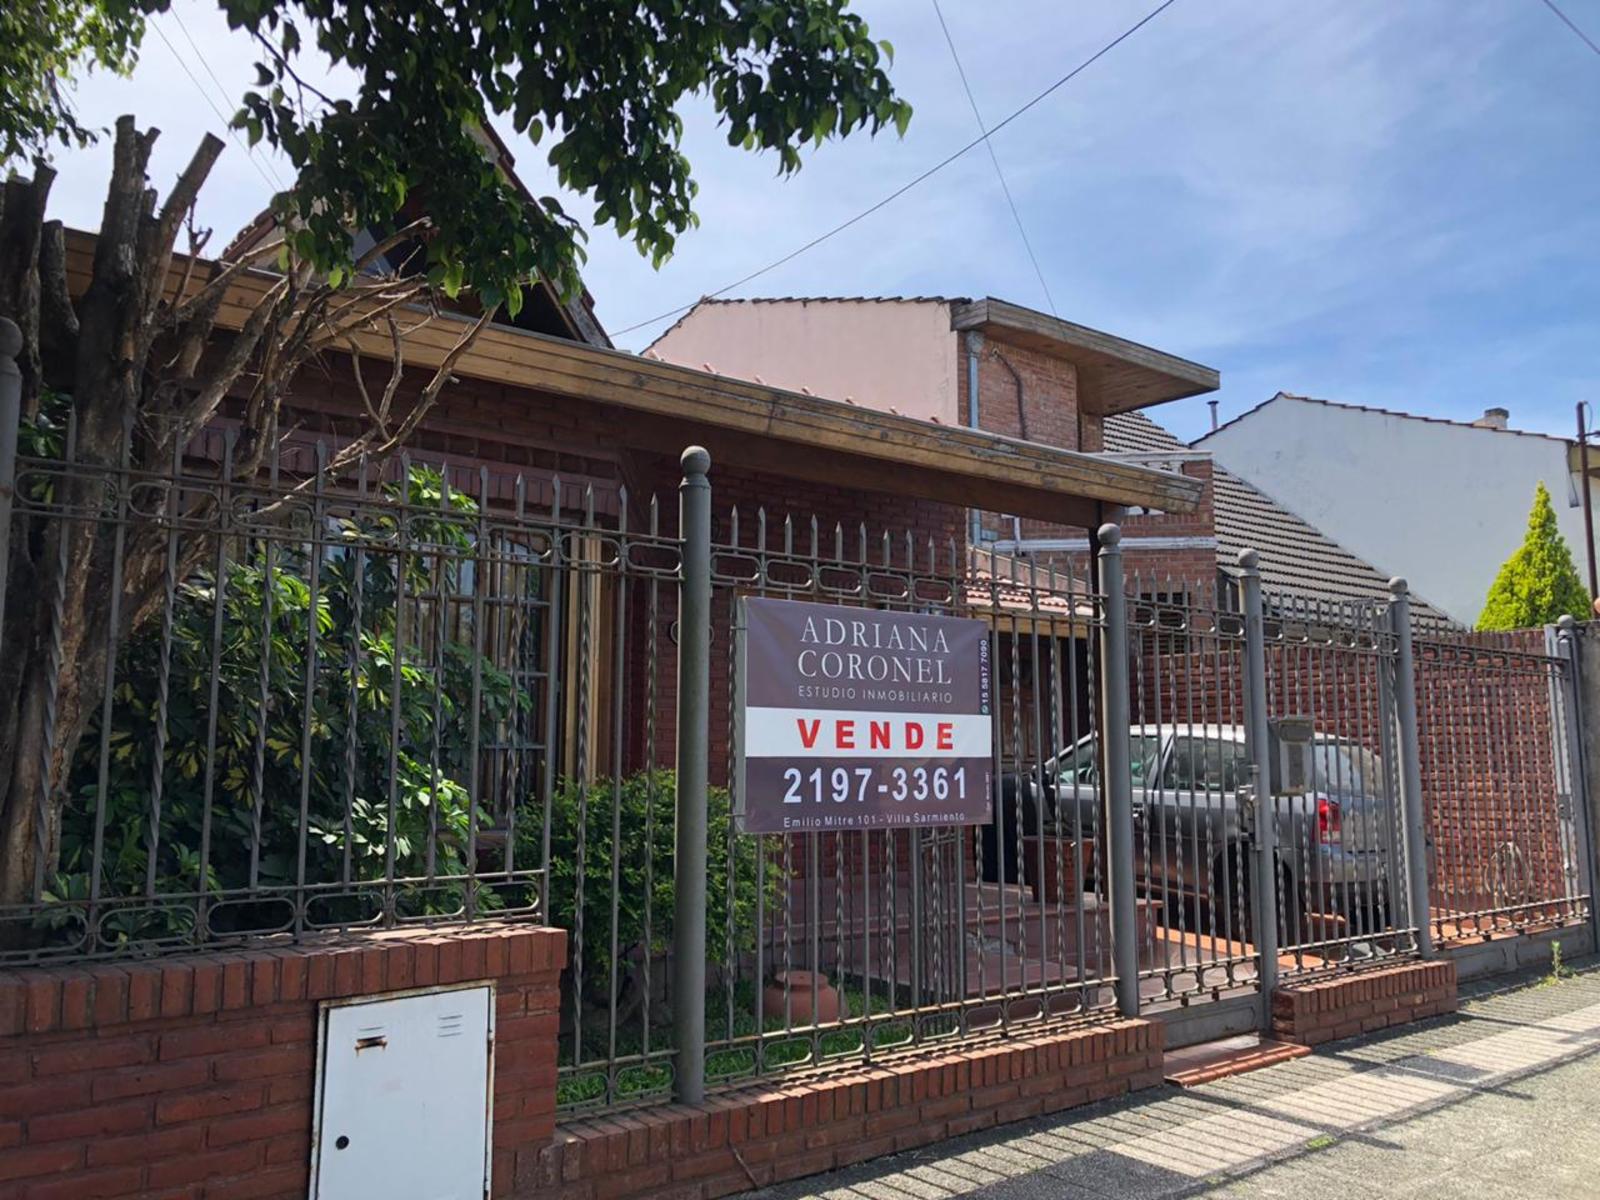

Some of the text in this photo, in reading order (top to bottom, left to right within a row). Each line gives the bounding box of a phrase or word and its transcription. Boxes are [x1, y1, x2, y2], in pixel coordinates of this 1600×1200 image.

[800, 615, 950, 653] ADRIANA
[797, 650, 951, 684] CORONEL
[798, 685, 953, 704] ESTUDIO INMOBILIARIO
[981, 692, 988, 704] 15
[797, 719, 953, 750] VENDE
[783, 767, 966, 804] 2197-3361
[783, 816, 822, 828] Emilio
[824, 815, 854, 827] Mitre
[858, 814, 877, 825] 101
[886, 813, 911, 824] Villa
[913, 812, 966, 823] Sarmiento
